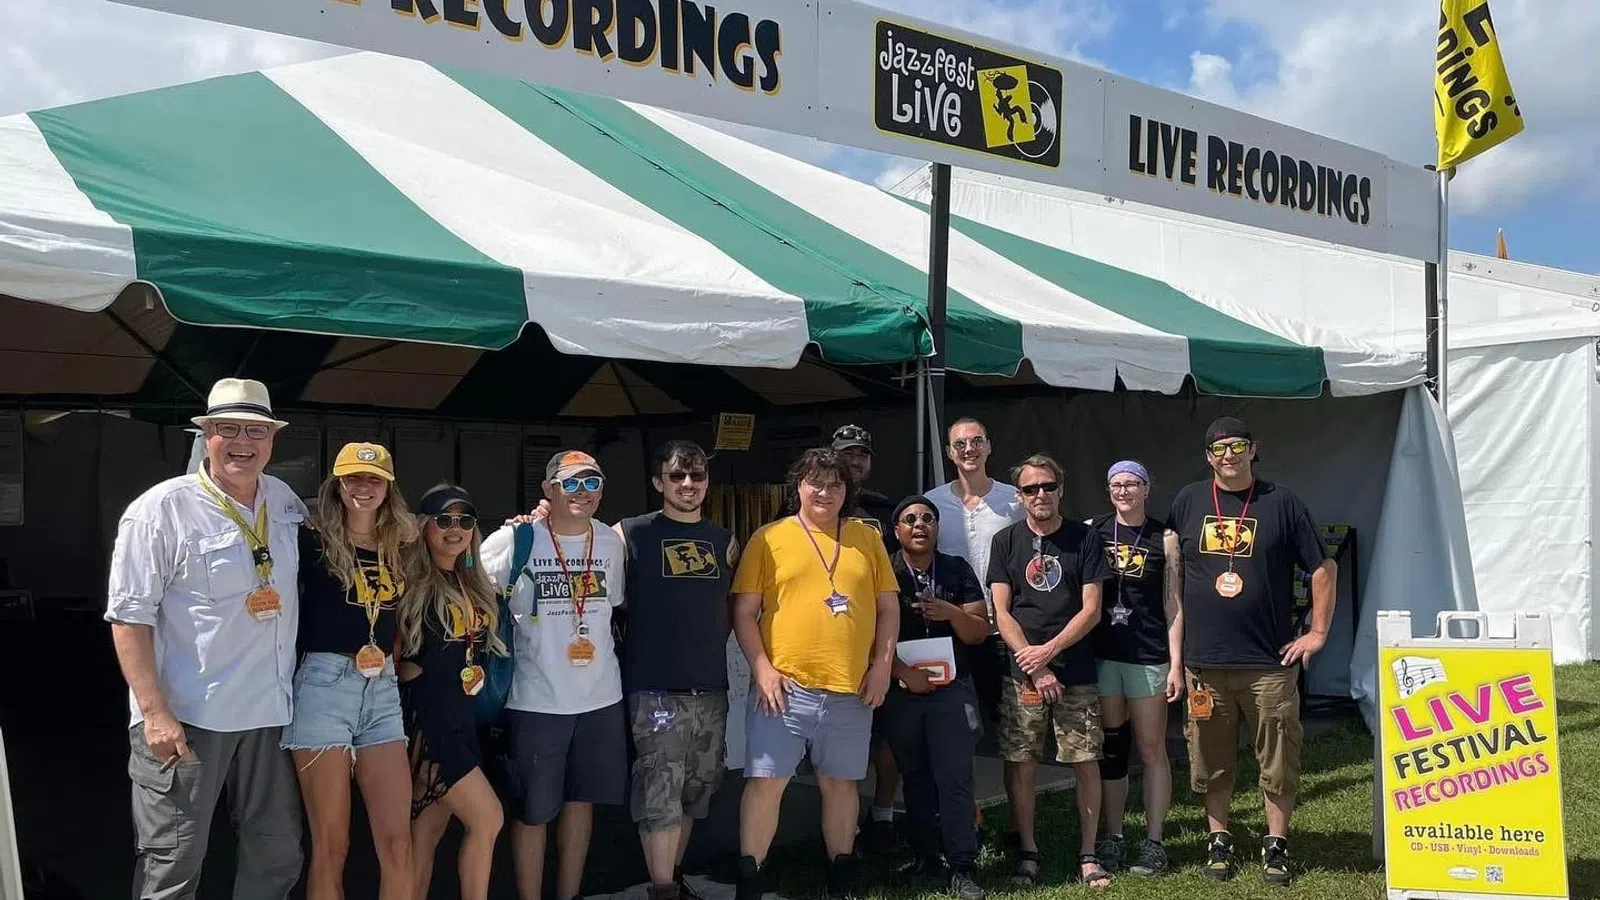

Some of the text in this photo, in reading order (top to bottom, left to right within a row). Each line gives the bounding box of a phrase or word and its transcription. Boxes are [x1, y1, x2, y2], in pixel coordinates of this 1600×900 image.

[1129, 114, 1371, 226] LIVE RECORDINGS
[1392, 675, 1544, 741] LIVE
[1393, 719, 1547, 779] FESTIVAL
[1394, 753, 1550, 811] RECORDINGS
[1404, 822, 1544, 842] available here
[1410, 842, 1540, 856] CD USB Vinyl Downloads
